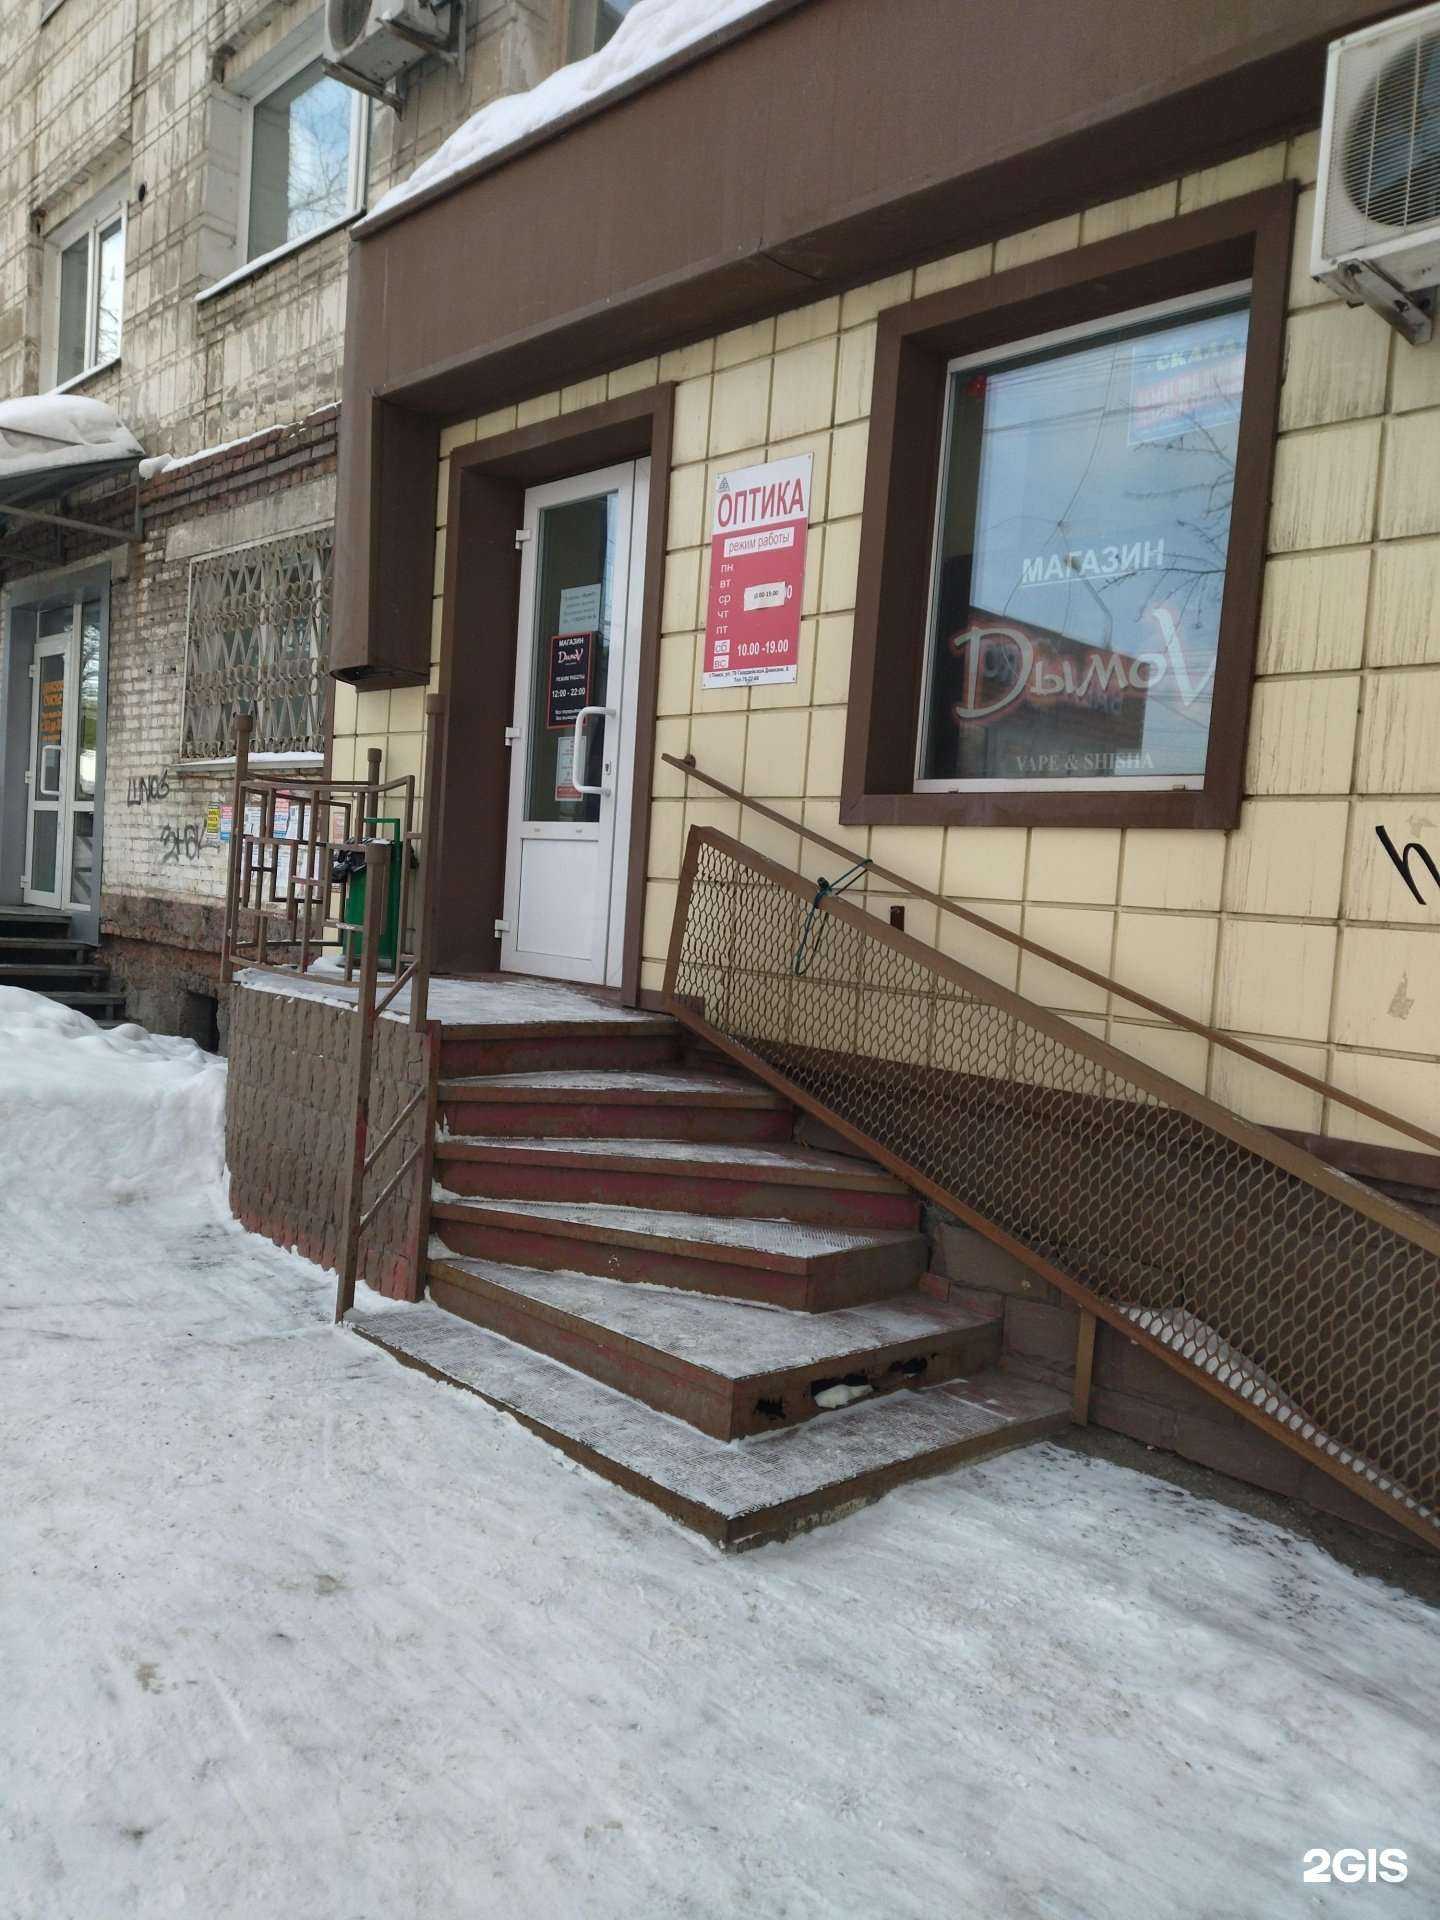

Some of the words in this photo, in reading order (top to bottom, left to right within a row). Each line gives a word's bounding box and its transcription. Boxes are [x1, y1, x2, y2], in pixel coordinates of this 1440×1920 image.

[718, 478, 804, 528] ОПТИКА
[729, 539, 756, 553] режим
[758, 532, 790, 552] работы
[1021, 539, 1166, 583] МАГАЗИН
[718, 595, 731, 605] ср
[558, 637, 584, 647] МАГАЗИН
[737, 642, 760, 656] 10.00
[552, 688, 566, 697] 12:00
[570, 687, 585, 696] 22:00
[1016, 754, 1060, 771] VAPE
[1064, 754, 1079, 771] &
[1084, 752, 1155, 770] SHISHA
